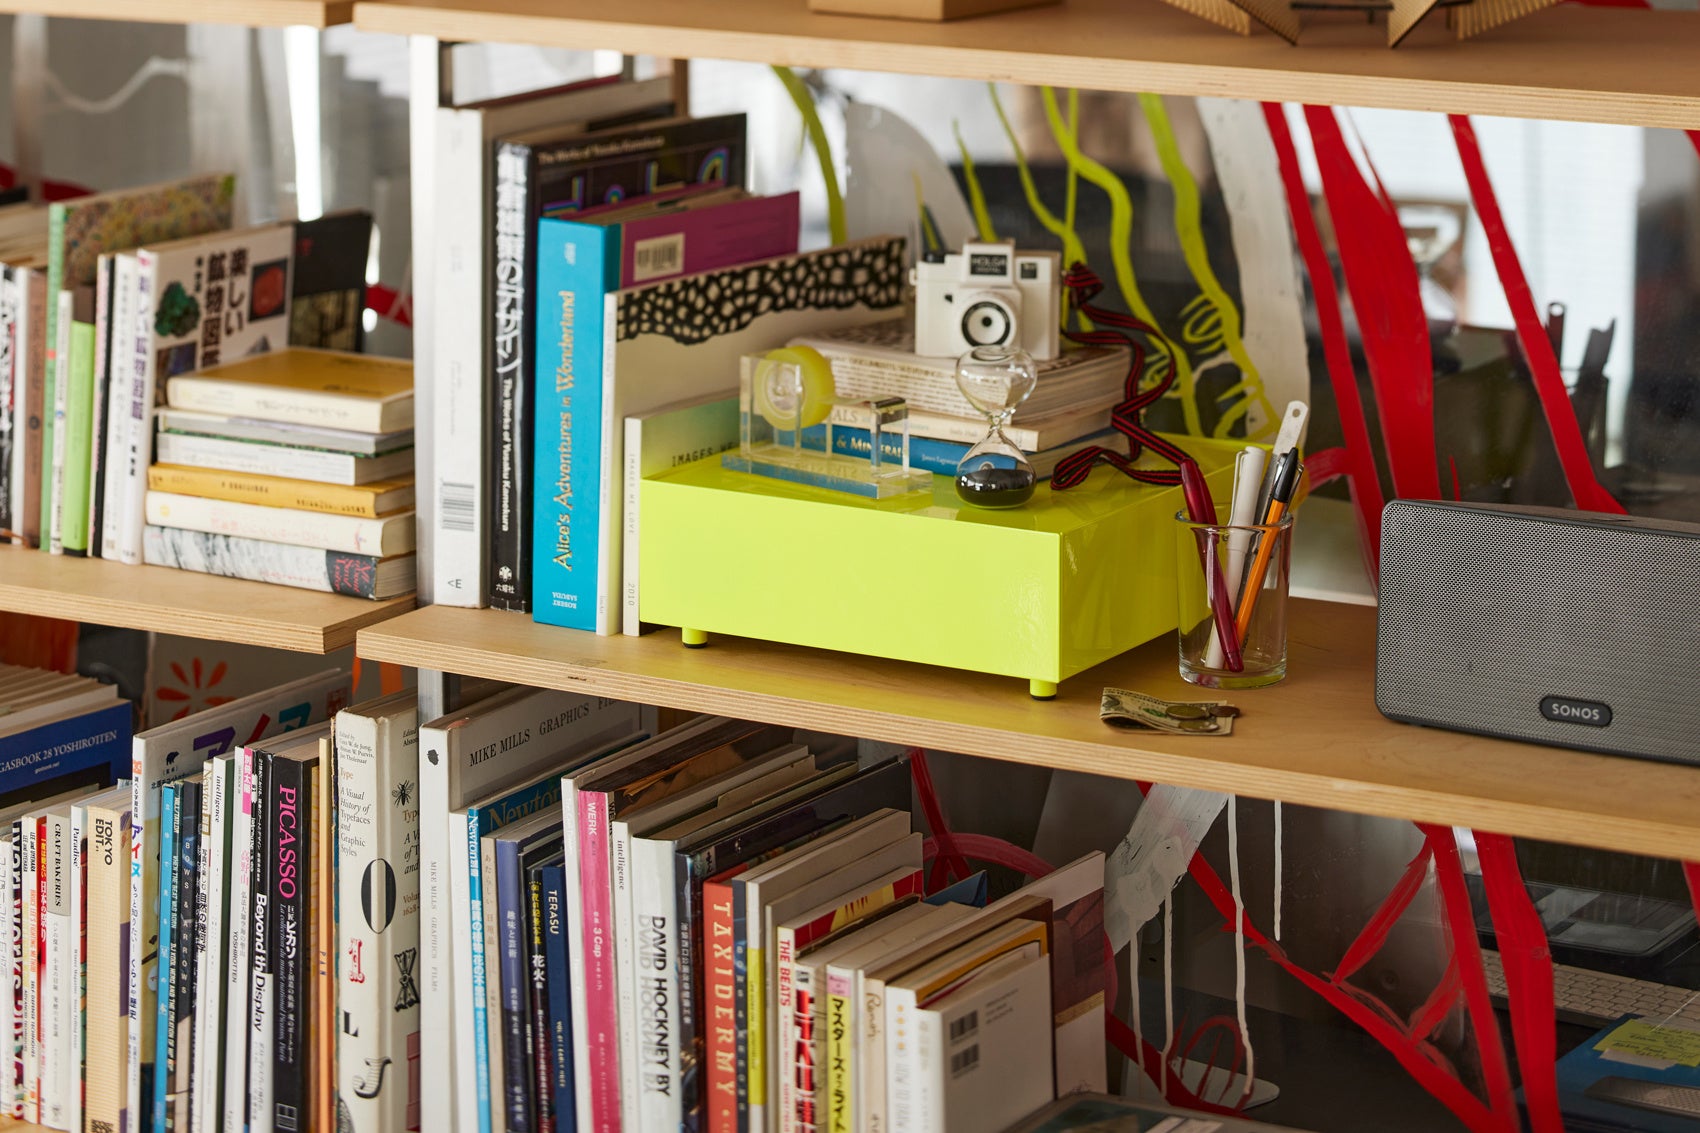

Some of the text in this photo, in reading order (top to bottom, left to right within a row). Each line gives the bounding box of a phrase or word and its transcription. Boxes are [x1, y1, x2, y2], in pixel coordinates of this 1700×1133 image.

[553, 290, 575, 571] Alice's Adventures in Wonderland
[502, 378, 512, 531] The Works of Yusaku Kamekura
[672, 447, 713, 467] IMAGES
[1551, 703, 1600, 720] SONOS
[43, 749, 53, 760] 28
[53, 730, 118, 757] YOSHIROTTEN
[469, 703, 590, 767] MIKE MILLS GRAPHICS
[340, 767, 354, 779] Type
[340, 799, 372, 815] History of
[346, 788, 365, 800] Visual
[95, 818, 104, 845] EDIT
[340, 809, 371, 825] Typefaces
[341, 824, 351, 832] and
[587, 802, 597, 835] WERK
[104, 820, 113, 865] TOKYO
[131, 823, 143, 878] アイヌ
[279, 784, 297, 899] PICASSO
[341, 833, 366, 847] Graphic
[341, 847, 358, 857] Styles
[182, 841, 191, 888] BOWS
[617, 840, 625, 890] intelligence
[255, 893, 267, 953] Beyond
[279, 903, 287, 913] La
[548, 889, 559, 935] TERASU
[279, 948, 286, 959] du
[286, 921, 297, 959] ピカソ
[506, 910, 517, 958] 趣味と芸術
[779, 940, 790, 963] THE
[181, 920, 190, 994] ARROWS
[253, 974, 266, 1032] Display
[652, 915, 671, 1097] DAVID HOCKNEY BY
[713, 902, 736, 1097] TAXIDERMY
[779, 967, 790, 1007] BEATS
